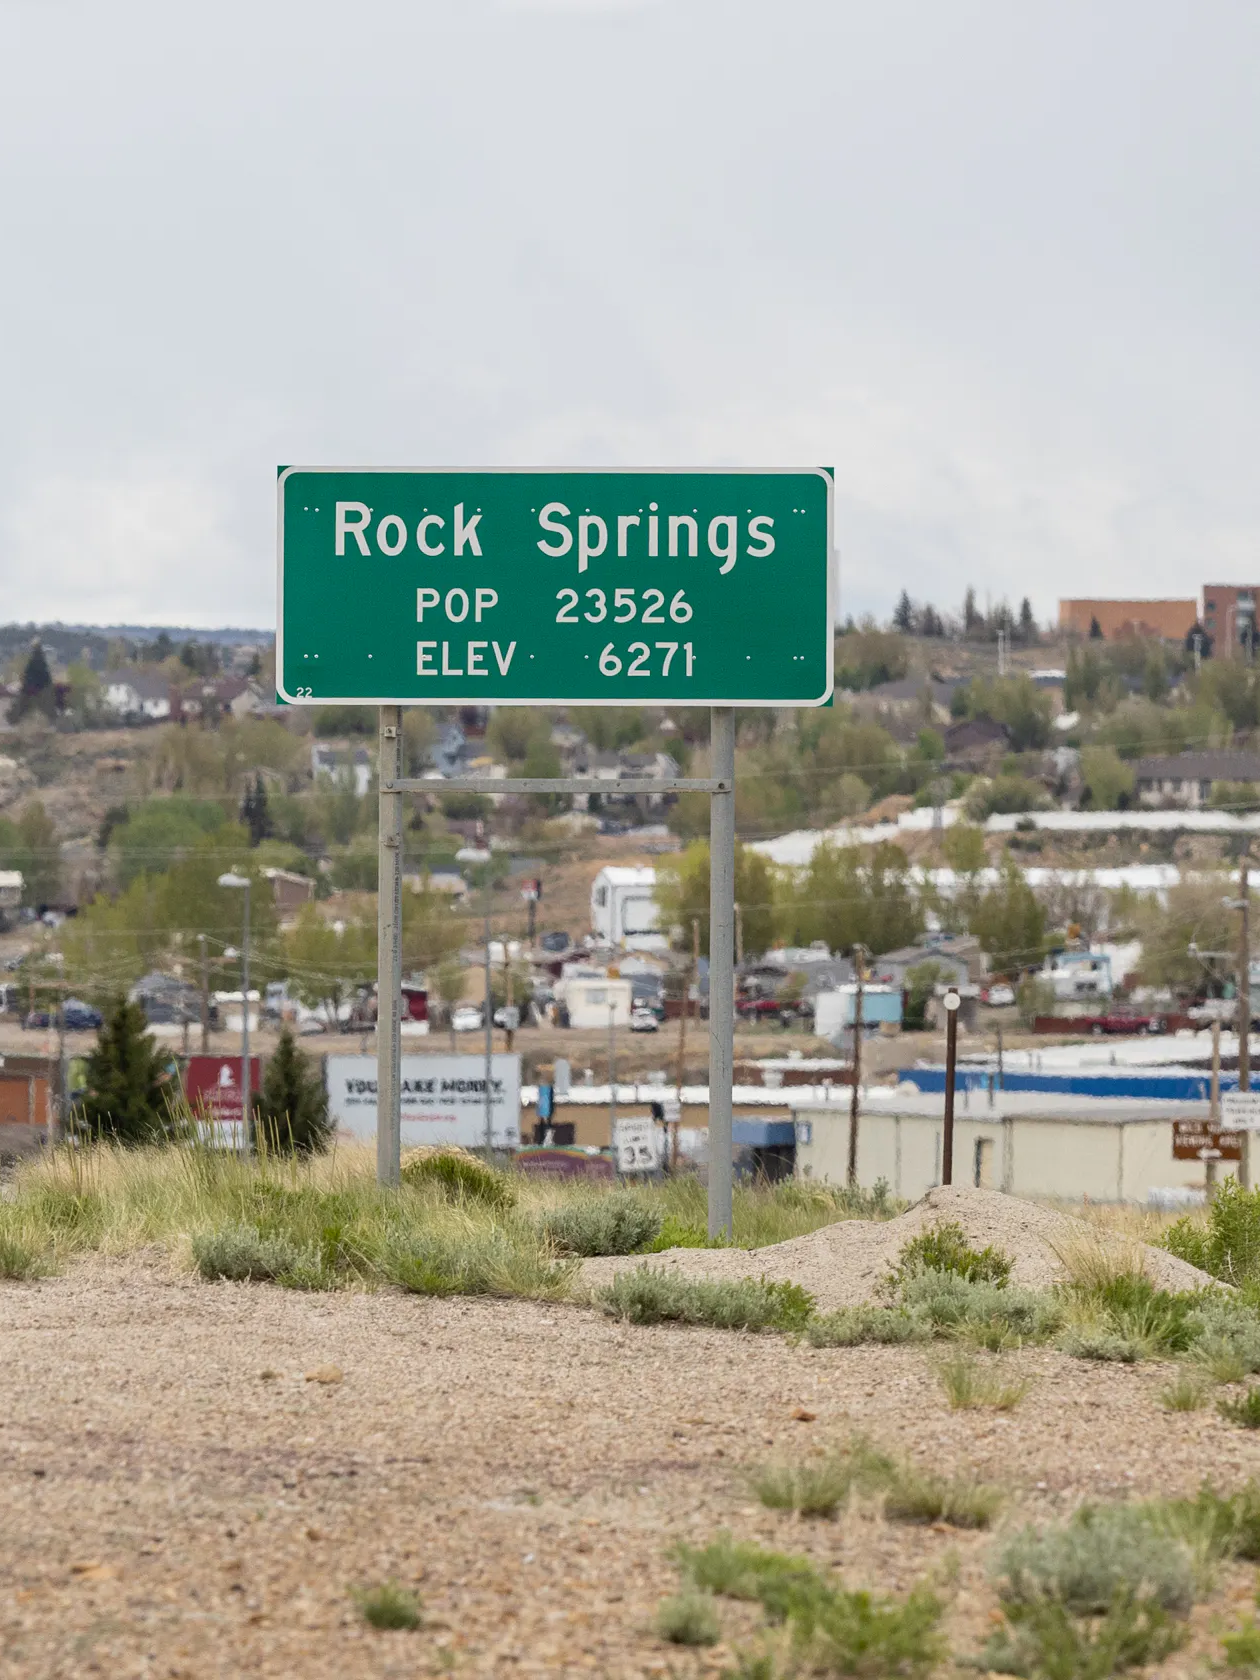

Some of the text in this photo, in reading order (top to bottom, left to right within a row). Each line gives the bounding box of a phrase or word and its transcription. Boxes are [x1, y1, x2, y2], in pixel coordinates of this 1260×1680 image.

[336, 502, 775, 574] Rock Springs
[417, 588, 692, 623] POP 23526
[417, 642, 696, 676] ELEV 6271
[296, 687, 312, 698] 22
[401, 1079, 436, 1093] AKE
[623, 1145, 652, 1164] 35
